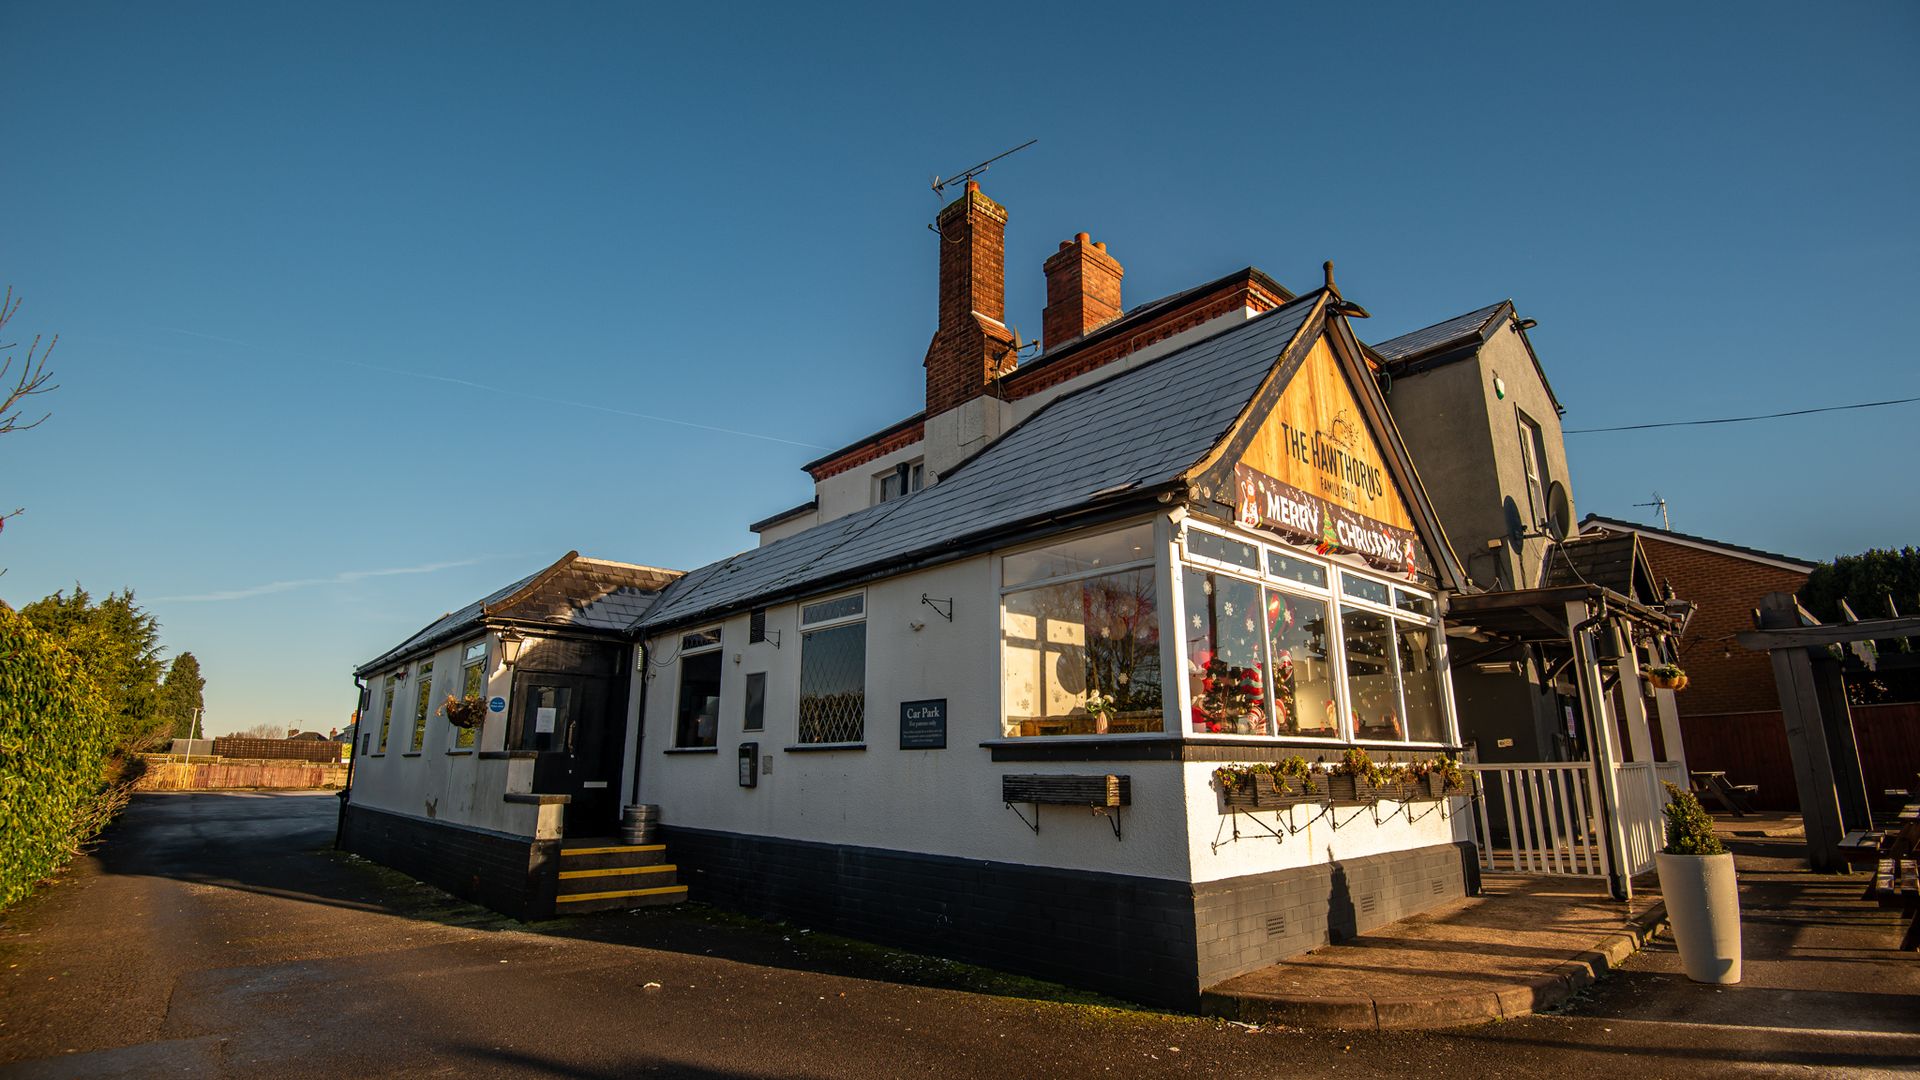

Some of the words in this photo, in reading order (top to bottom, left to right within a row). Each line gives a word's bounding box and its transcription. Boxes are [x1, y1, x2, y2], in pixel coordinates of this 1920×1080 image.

[1281, 422, 1309, 464] THE
[1311, 430, 1383, 501] HAWTHORNS
[1320, 476, 1340, 497] FAMILY
[1267, 490, 1319, 535] MERRY
[1336, 519, 1403, 563] CHRISTMAS
[907, 708, 920, 719] Car
[922, 706, 940, 718] Park
